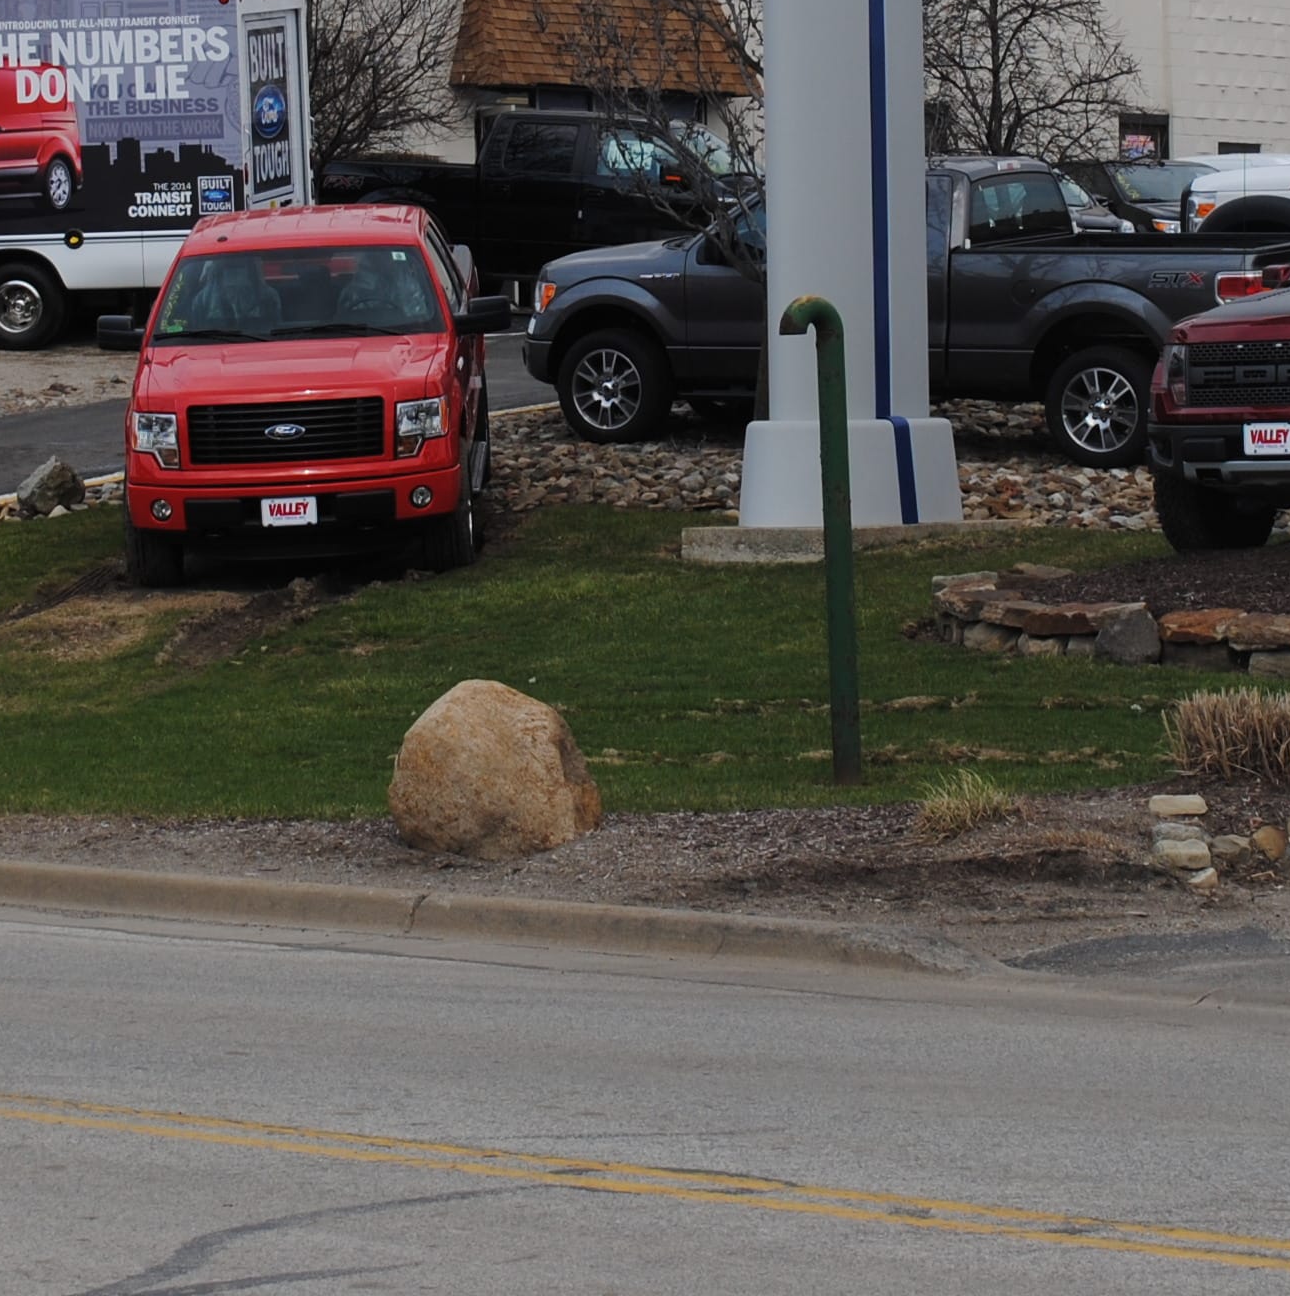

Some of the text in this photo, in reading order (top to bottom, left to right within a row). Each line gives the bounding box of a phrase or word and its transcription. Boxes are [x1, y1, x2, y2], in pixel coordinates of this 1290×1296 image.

[60, 19, 78, 29] THE
[79, 18, 118, 29] ALL-NEW
[120, 16, 157, 27] TRANSIT
[159, 15, 200, 26] CONNECT
[51, 26, 230, 67] NUMBERS
[249, 32, 285, 83] BUILT
[16, 66, 124, 105] DON'T
[134, 64, 190, 101] LIE
[86, 98, 220, 116] THE BUSINESS
[89, 118, 222, 139] NOW OWN THE WORK
[254, 140, 290, 183] TOUGH
[153, 182, 192, 191] THE 2014
[200, 178, 231, 190] BUILT
[134, 191, 192, 204] TRANSIT
[128, 204, 192, 218] CONNECT
[202, 202, 231, 211] TOUGH
[1150, 271, 1206, 284] STX
[1250, 429, 1290, 444] VALLEY
[268, 501, 309, 517] VALLEY
